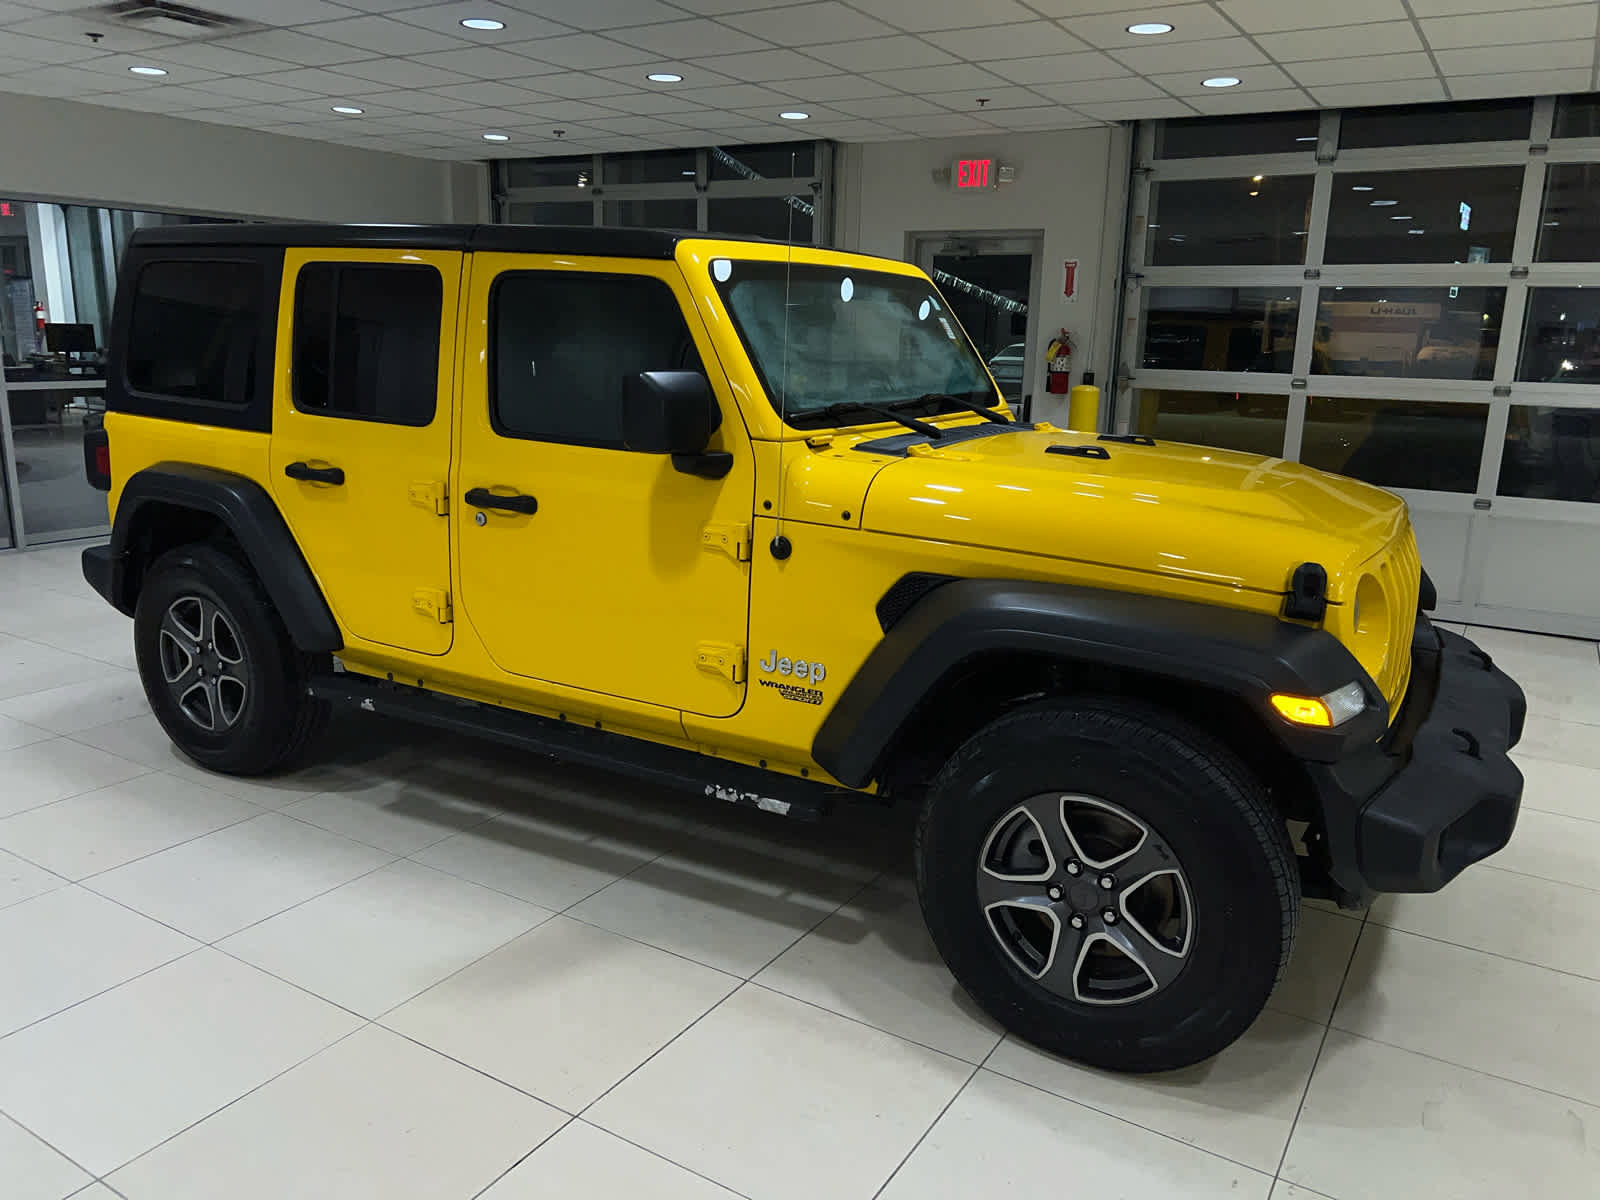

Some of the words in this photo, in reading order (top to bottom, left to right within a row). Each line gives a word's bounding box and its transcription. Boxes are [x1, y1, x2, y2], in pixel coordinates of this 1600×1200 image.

[957, 159, 991, 188] EXIT
[760, 649, 826, 685] Jeep
[758, 678, 823, 697] WRANGLER
